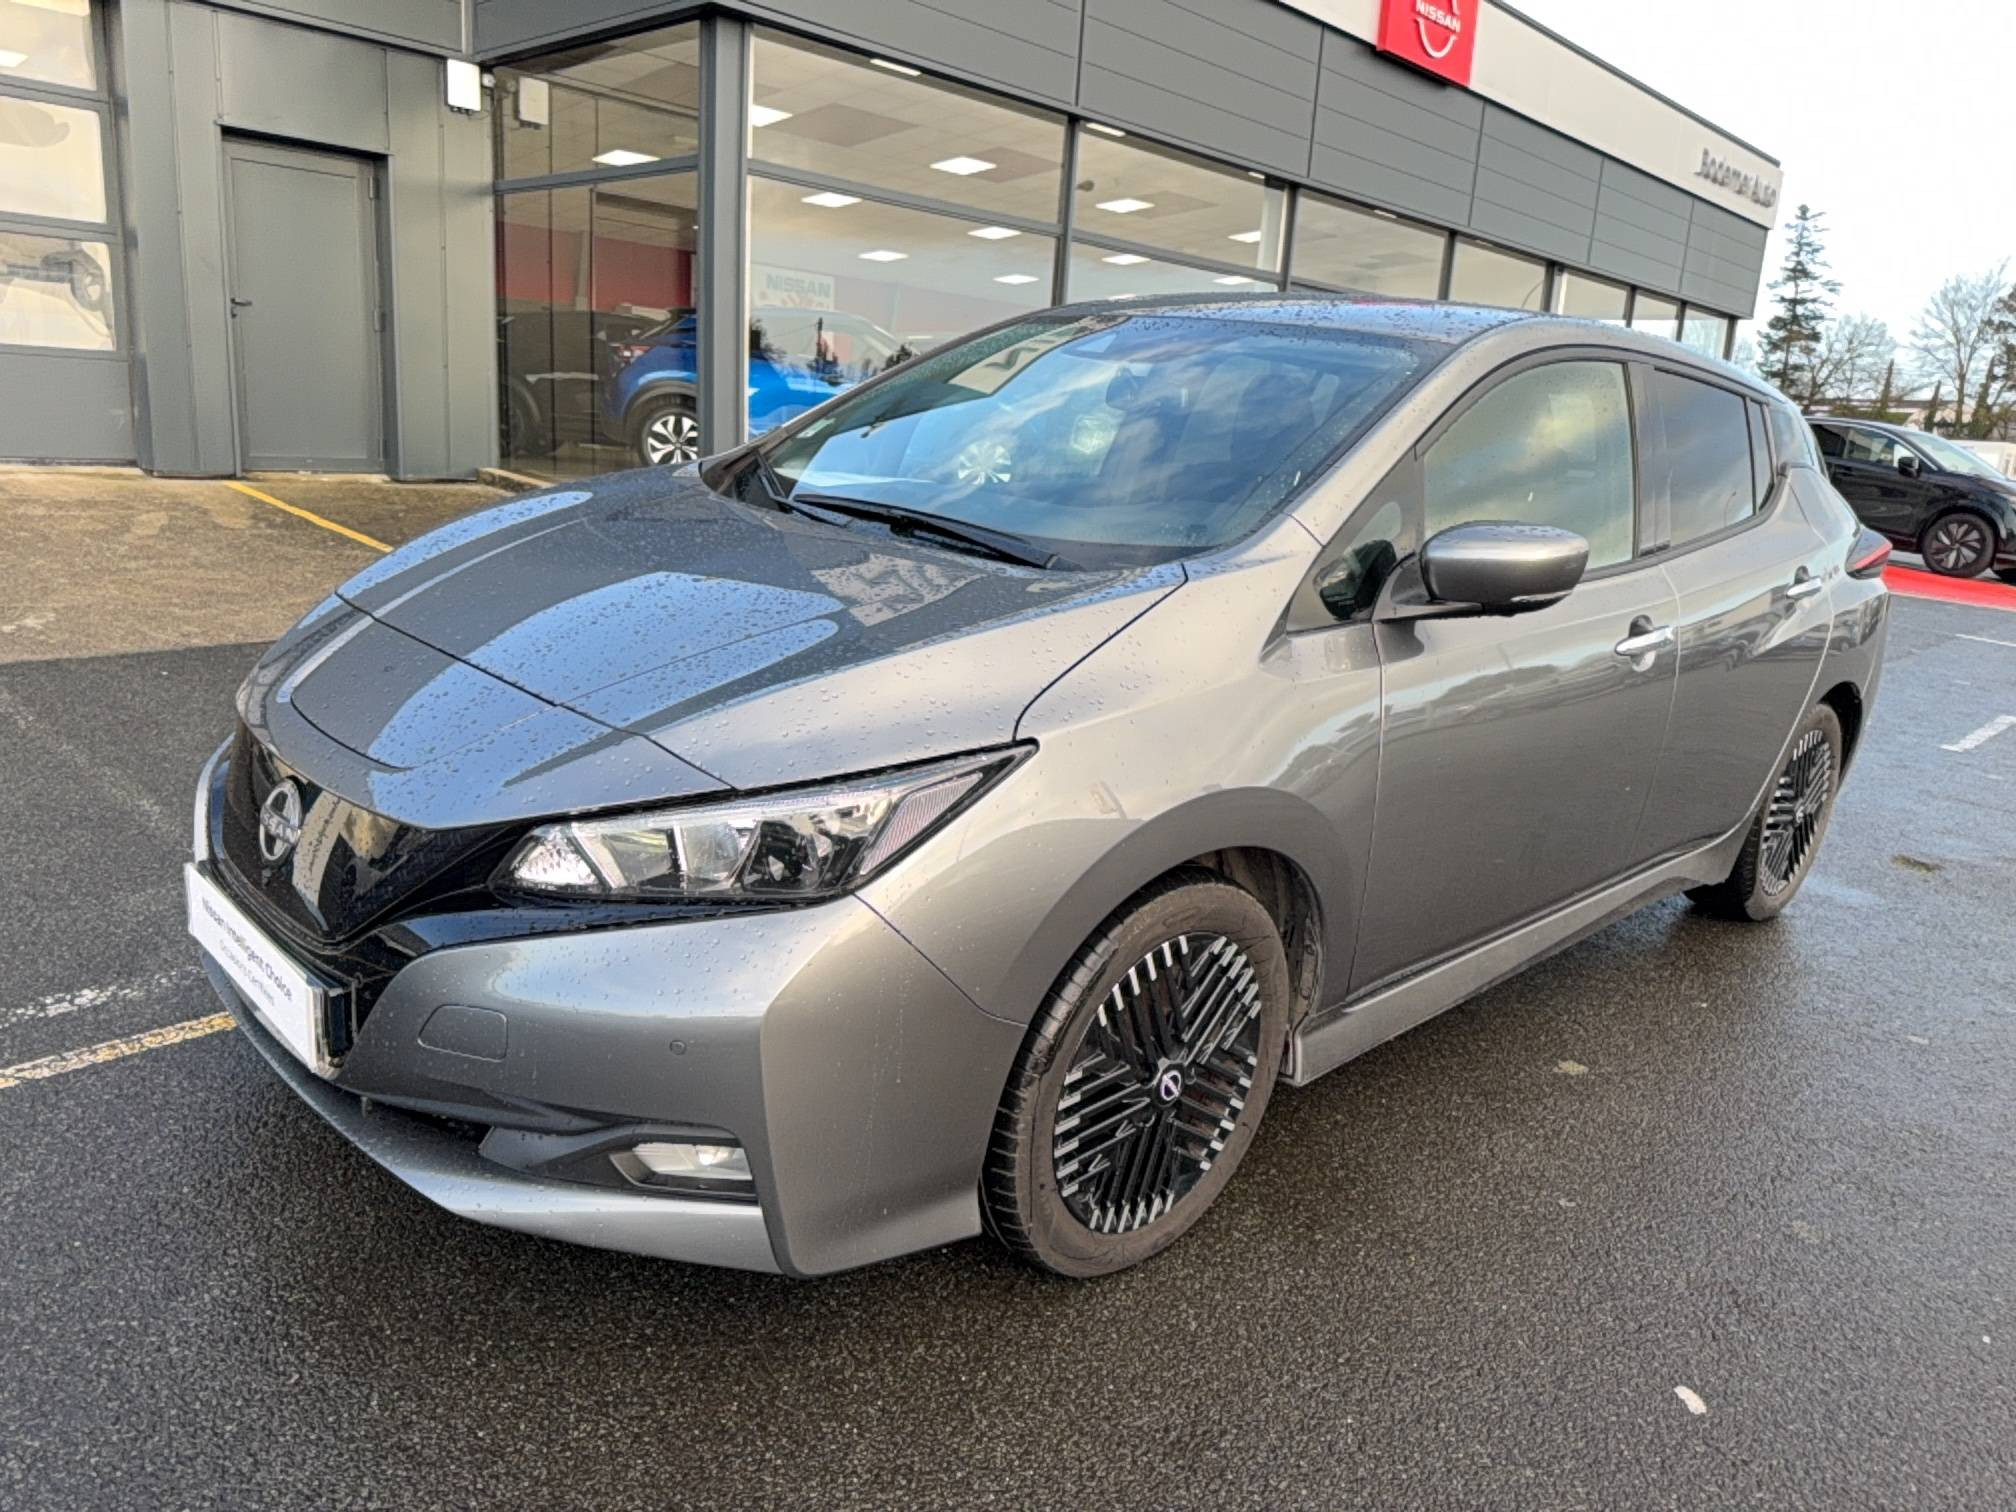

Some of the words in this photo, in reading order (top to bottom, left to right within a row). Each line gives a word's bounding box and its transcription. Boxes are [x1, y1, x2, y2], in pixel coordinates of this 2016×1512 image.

[1416, 0, 1461, 33] NISSAN
[766, 274, 831, 299] NISSAN
[265, 962, 293, 1001] Choice
